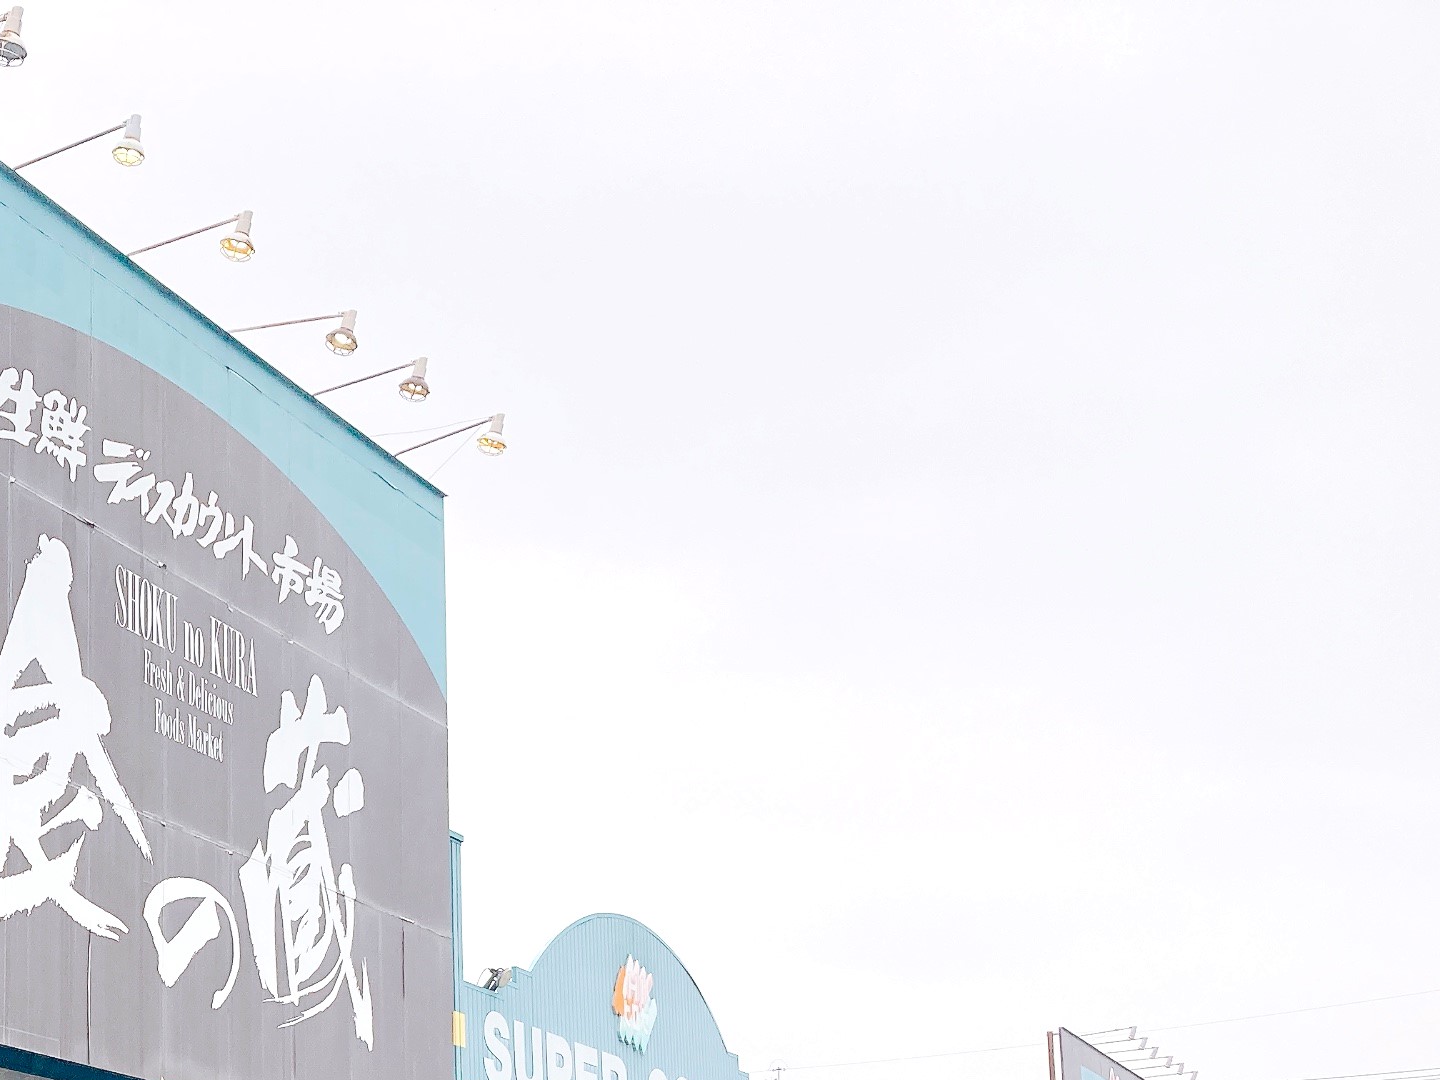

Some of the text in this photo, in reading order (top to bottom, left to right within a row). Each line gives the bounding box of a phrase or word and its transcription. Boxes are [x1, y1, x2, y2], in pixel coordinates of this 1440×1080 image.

[115, 564, 258, 698] SHOKU no KURA
[144, 648, 235, 726] Fresh & Delicious
[154, 697, 224, 763] Foods Market
